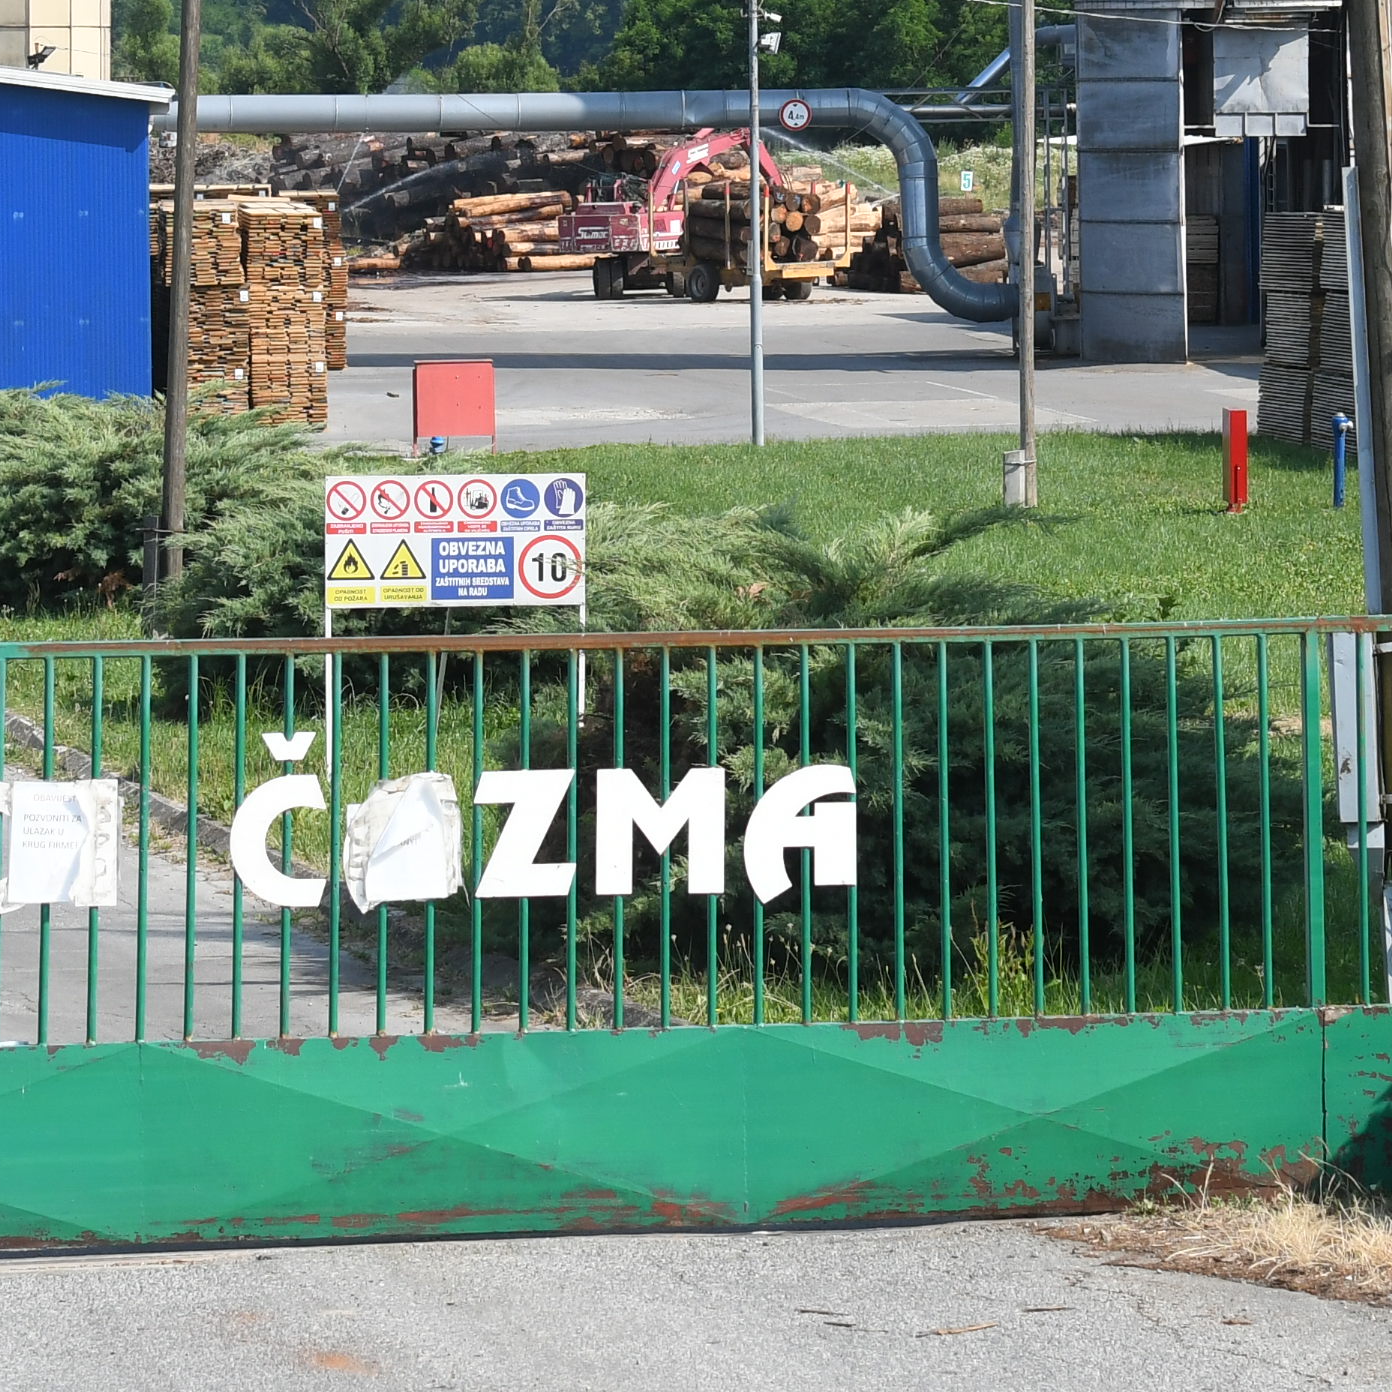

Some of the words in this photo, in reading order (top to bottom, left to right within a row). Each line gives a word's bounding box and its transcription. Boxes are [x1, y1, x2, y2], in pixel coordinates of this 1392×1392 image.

[963, 173, 971, 189] 5
[439, 541, 505, 556] OBVEZNA
[439, 559, 506, 574] UPORABA
[532, 552, 567, 582] 10
[435, 576, 471, 587] ZAŠTITNIH
[472, 576, 509, 586] SREDSTAVA
[458, 588, 468, 596] NA
[469, 587, 487, 596] RADU
[23, 813, 70, 823] POZVONITI
[71, 813, 83, 823] ZA
[230, 732, 858, 908] ČZMA
[22, 826, 55, 836] ULAZAK
[57, 827, 64, 836] U
[21, 840, 46, 850] KRUG
